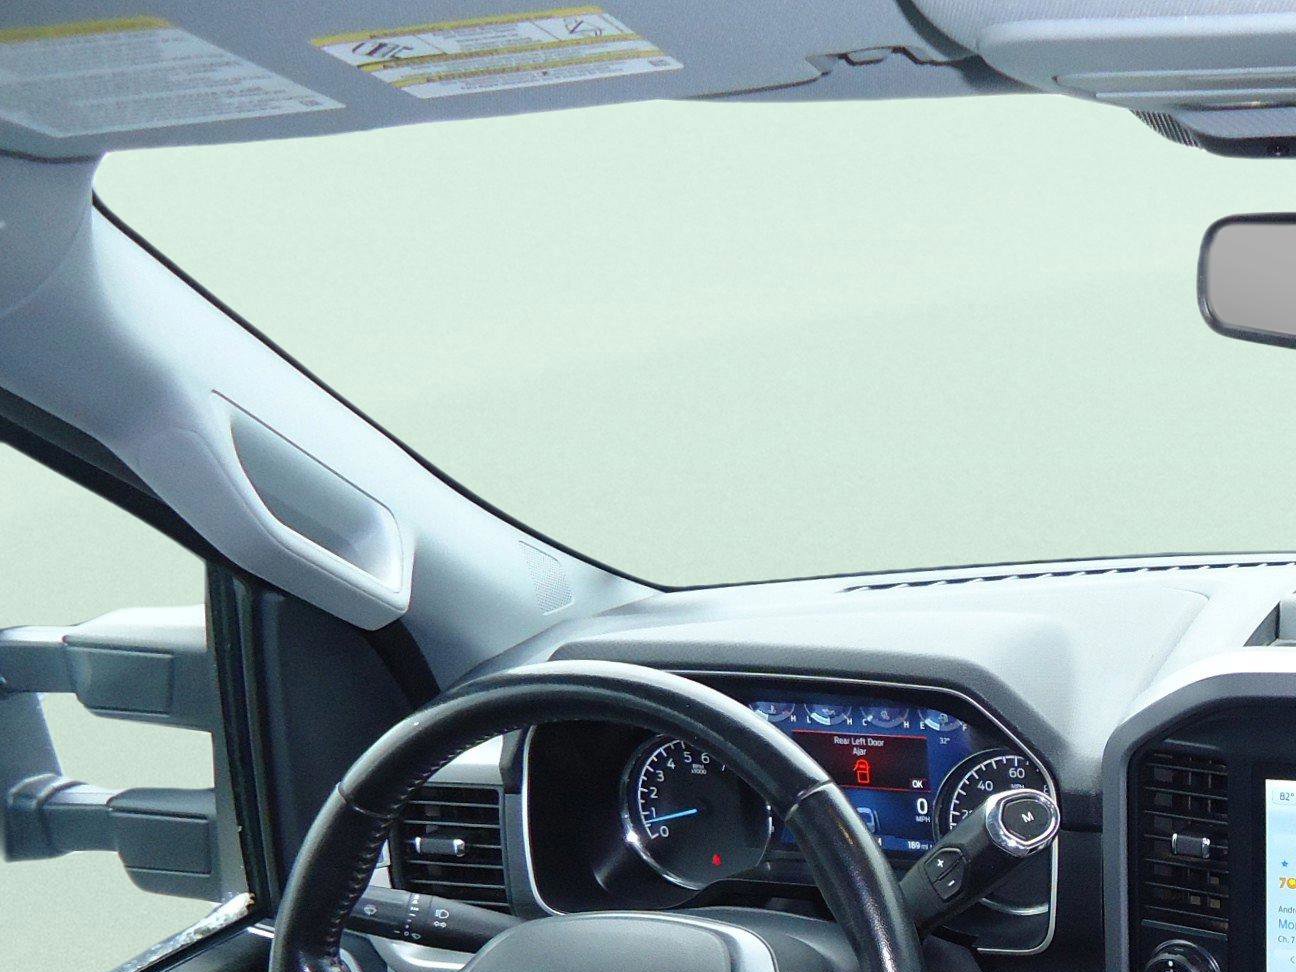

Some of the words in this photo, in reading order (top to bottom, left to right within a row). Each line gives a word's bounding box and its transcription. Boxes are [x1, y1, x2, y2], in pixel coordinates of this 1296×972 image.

[791, 714, 796, 722] H
[806, 716, 812, 724] L
[904, 720, 910, 729] H
[920, 722, 925, 730] E
[834, 736, 850, 745] Rear
[851, 737, 866, 746] Left
[868, 738, 884, 747] Door
[852, 747, 867, 756] Ajar
[684, 752, 692, 763] 5
[702, 752, 710, 764] 6
[666, 758, 676, 770] 4
[656, 770, 664, 782] 3
[1008, 768, 1025, 778] 60
[912, 779, 923, 788] OK
[977, 780, 994, 791] 40
[650, 786, 658, 799] 2
[1279, 792, 1295, 801] 82°
[916, 798, 928, 814] 0
[916, 815, 931, 823] MPH
[1021, 811, 1035, 823] M
[660, 825, 669, 838] 0
[908, 840, 920, 850] 189
